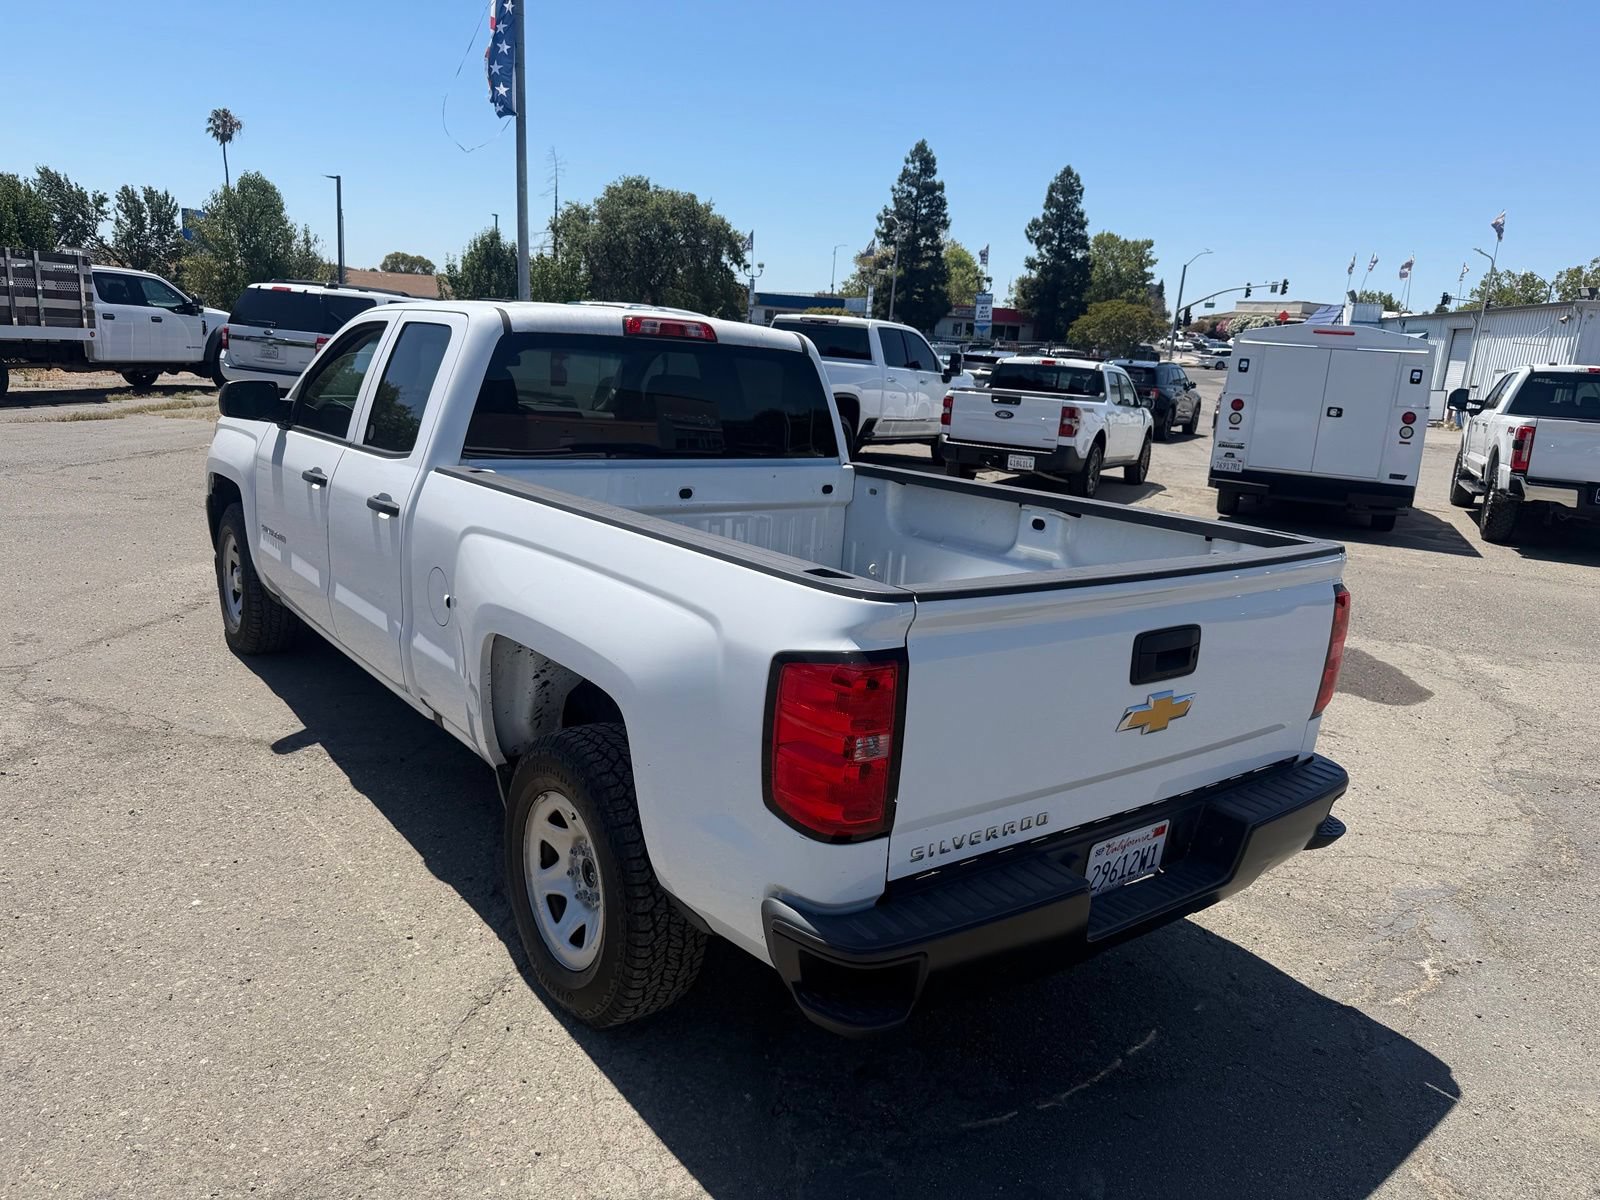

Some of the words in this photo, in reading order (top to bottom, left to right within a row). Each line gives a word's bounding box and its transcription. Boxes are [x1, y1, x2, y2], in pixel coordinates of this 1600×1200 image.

[909, 811, 1049, 863] SILVERADO
[1105, 832, 1153, 856] California
[1090, 843, 1158, 891] 29612W1
